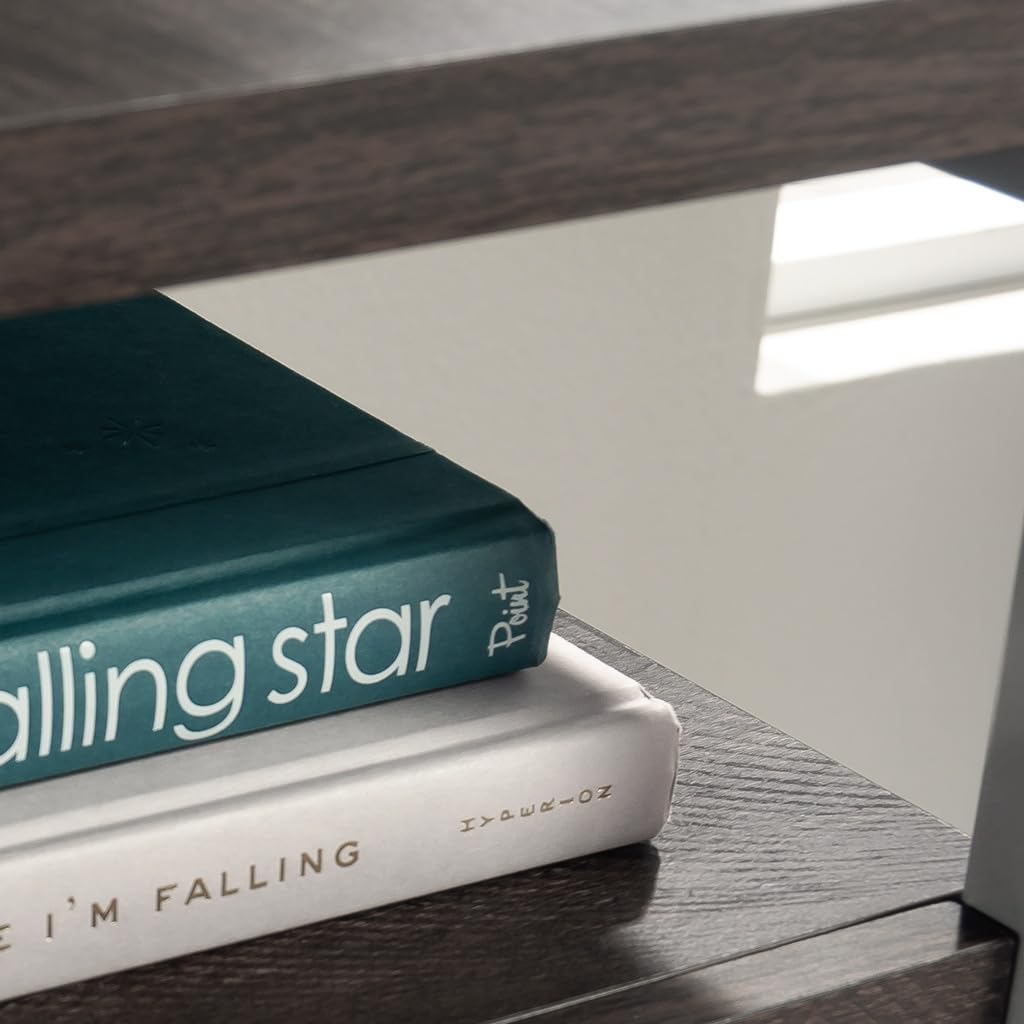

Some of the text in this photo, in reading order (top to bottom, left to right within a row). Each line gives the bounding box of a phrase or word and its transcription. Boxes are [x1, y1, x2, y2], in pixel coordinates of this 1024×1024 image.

[267, 592, 451, 705] star
[487, 572, 530, 658] Point
[460, 783, 614, 832] HYPERION
[45, 897, 120, 941] I'M
[155, 840, 362, 913] FALLING
